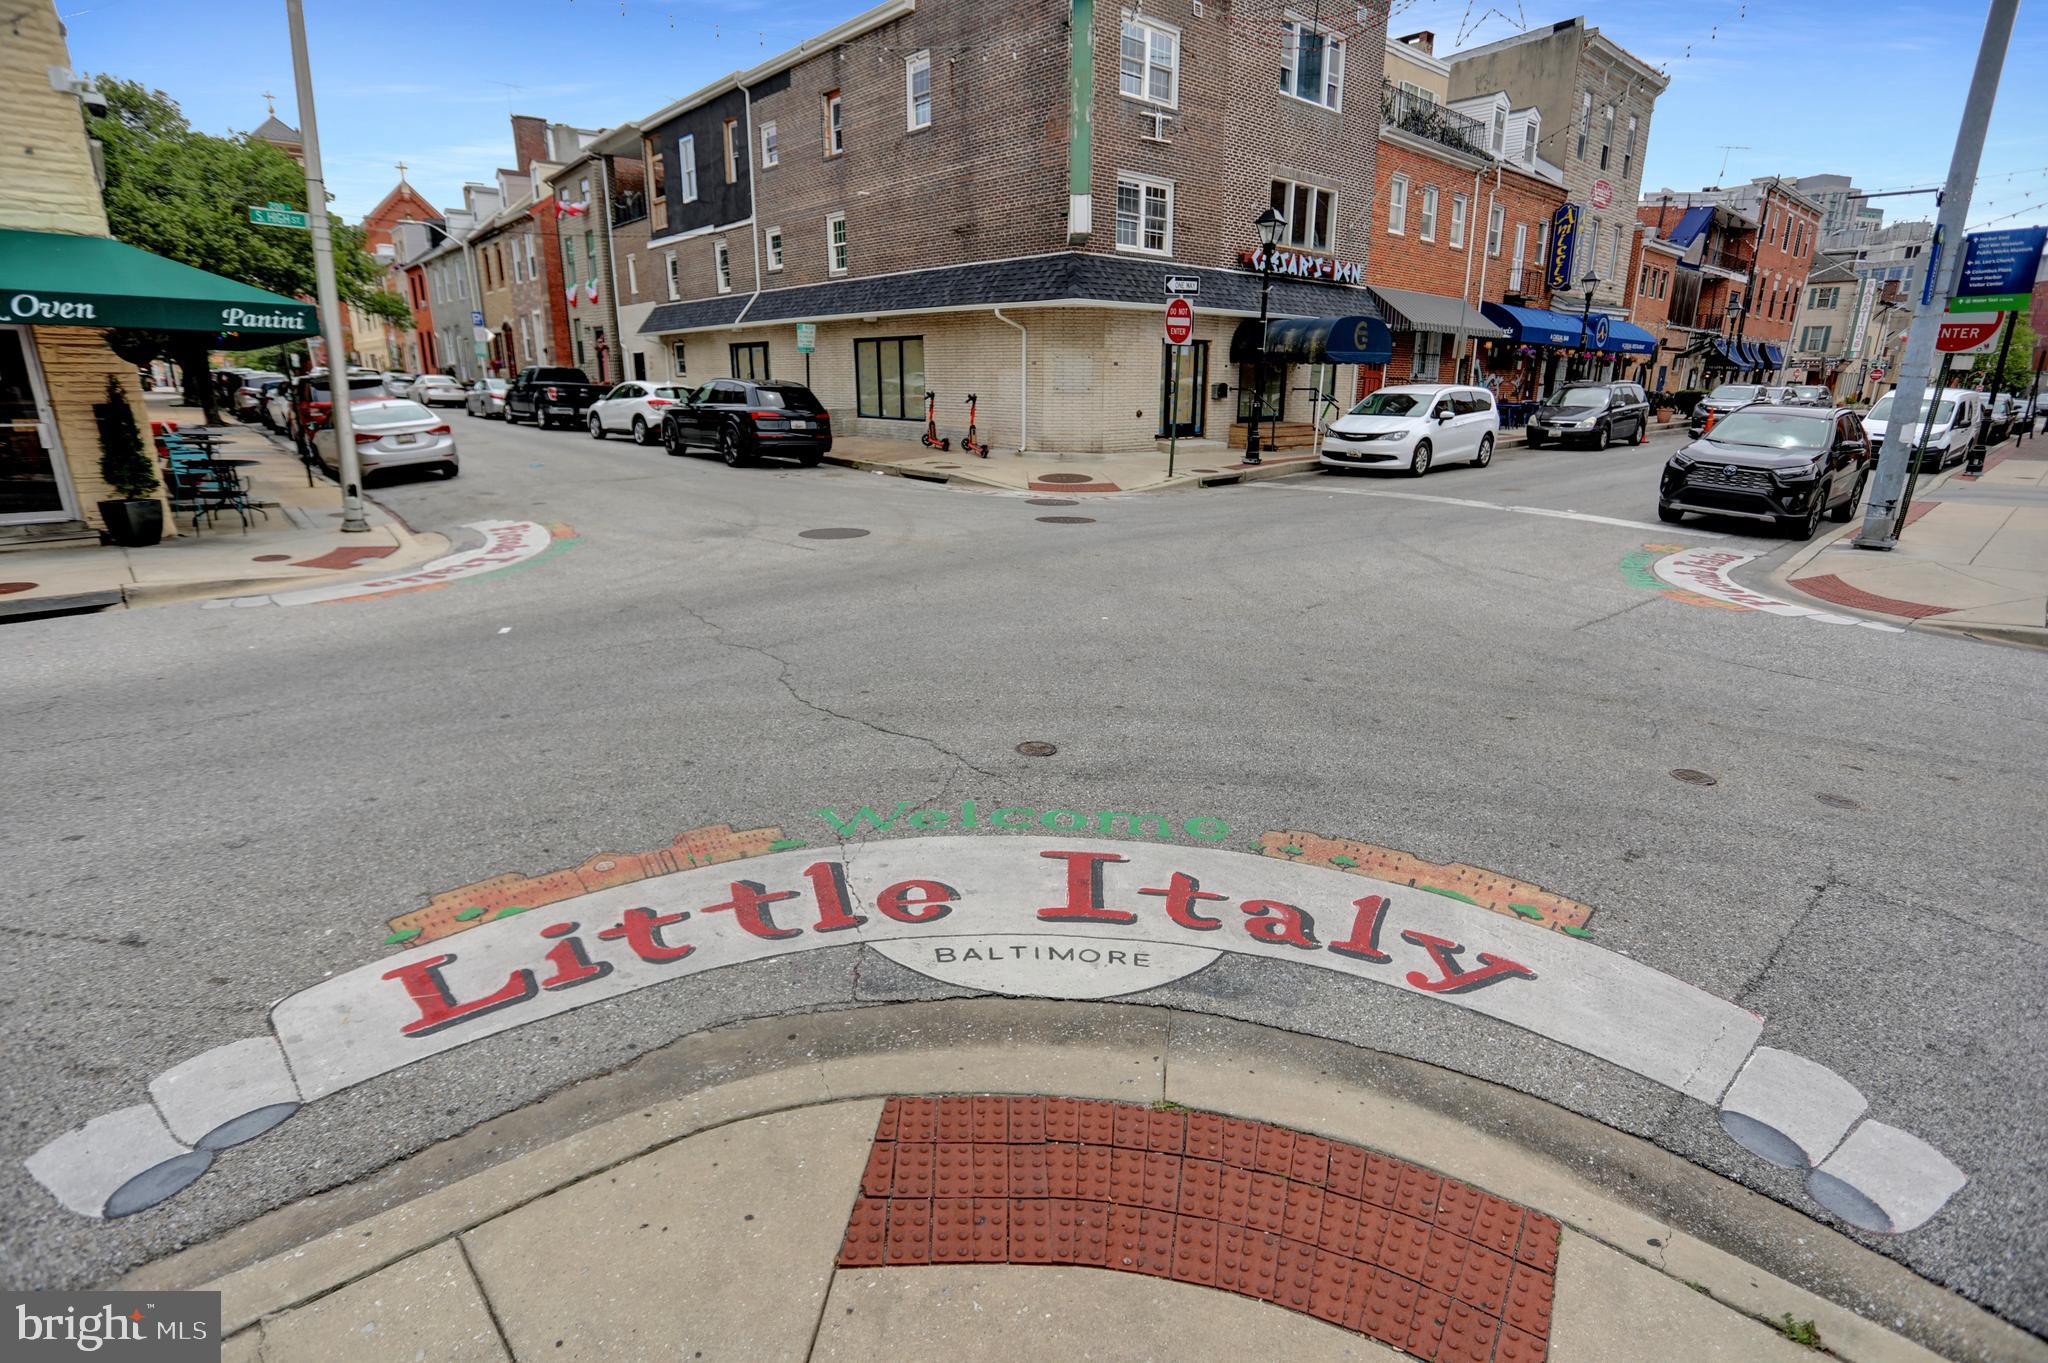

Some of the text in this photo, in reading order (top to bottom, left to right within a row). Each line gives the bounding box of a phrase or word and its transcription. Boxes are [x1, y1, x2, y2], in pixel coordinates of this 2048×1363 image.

[1174, 281, 1184, 289] ONE
[10, 294, 305, 331] Oven Panini
[1170, 327, 1186, 335] ENTER
[1939, 327, 1981, 339] NTER
[814, 799, 1230, 842] Welcome
[381, 850, 1538, 1039] Little Italy
[934, 944, 1152, 969] BALTIMORE
